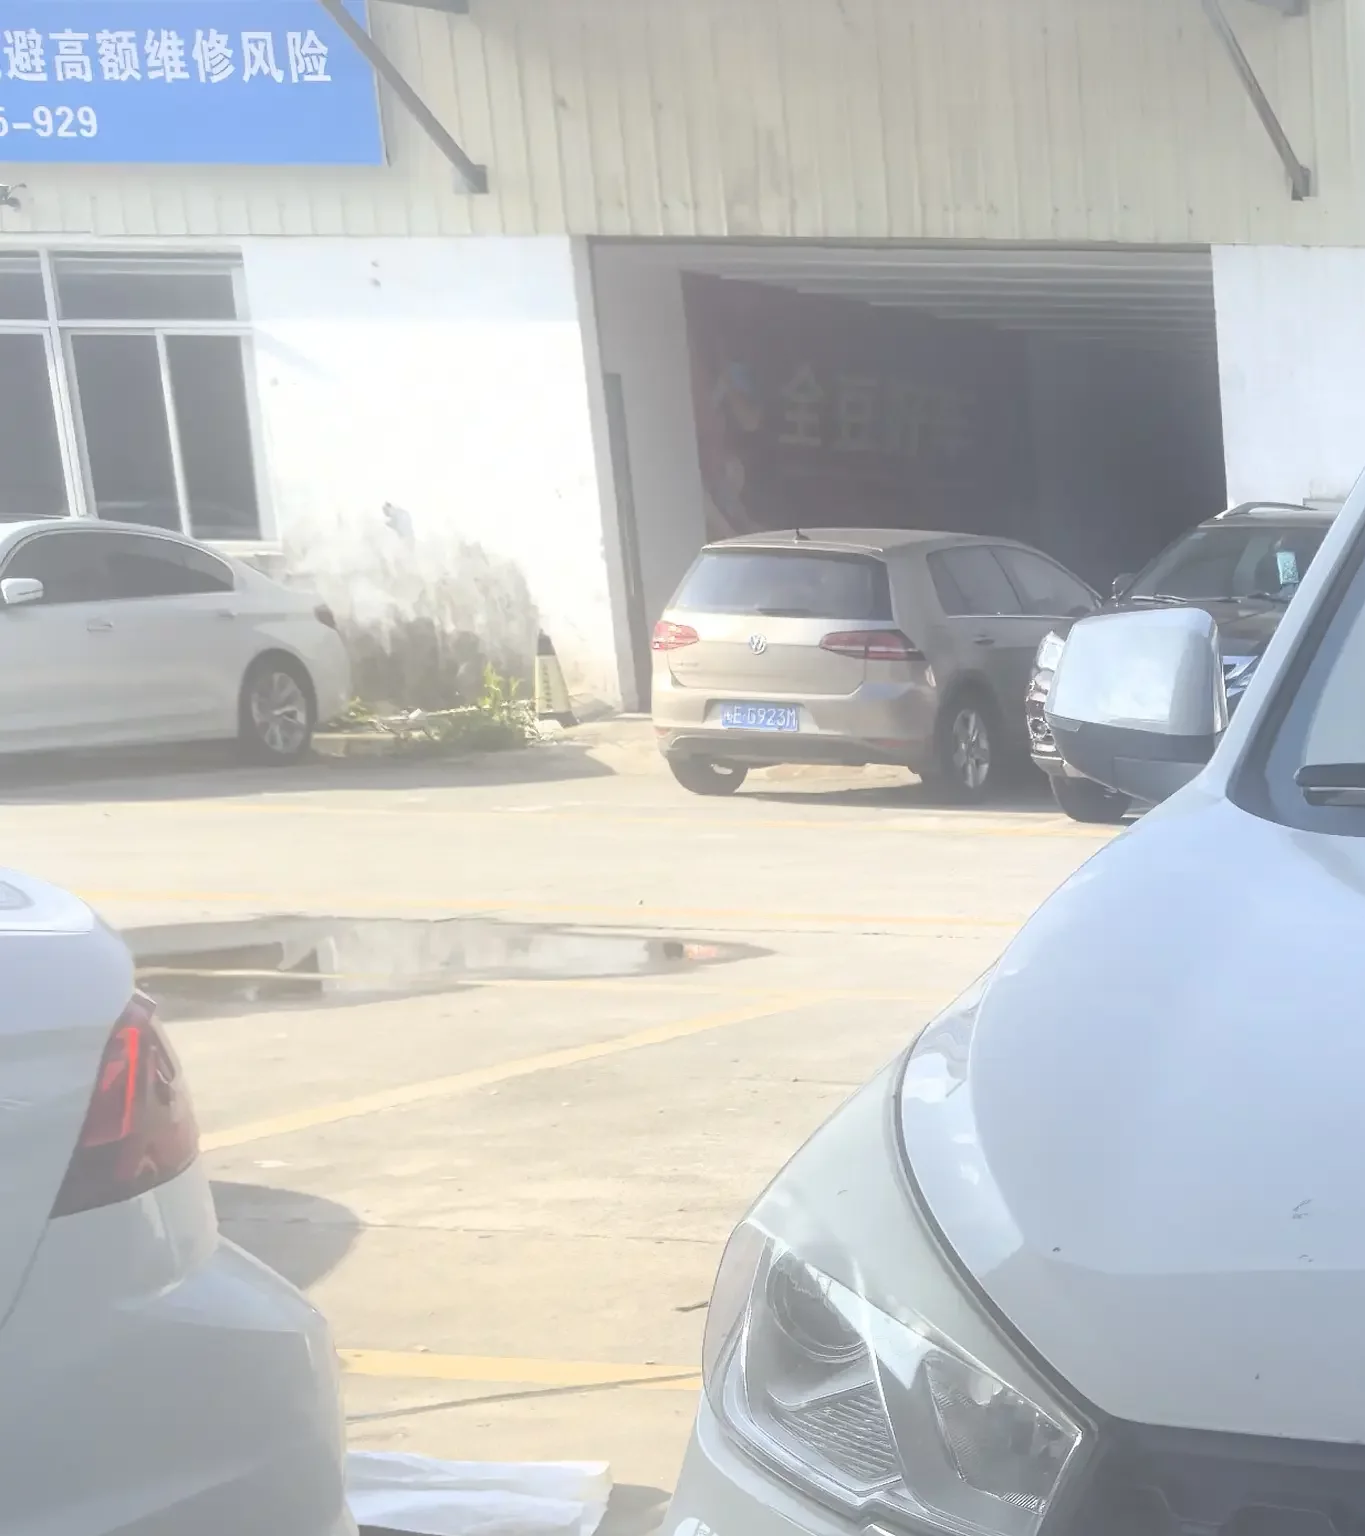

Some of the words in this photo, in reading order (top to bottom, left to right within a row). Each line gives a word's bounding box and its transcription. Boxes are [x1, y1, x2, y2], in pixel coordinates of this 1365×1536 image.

[3, 28, 332, 84] 避高额维修风险
